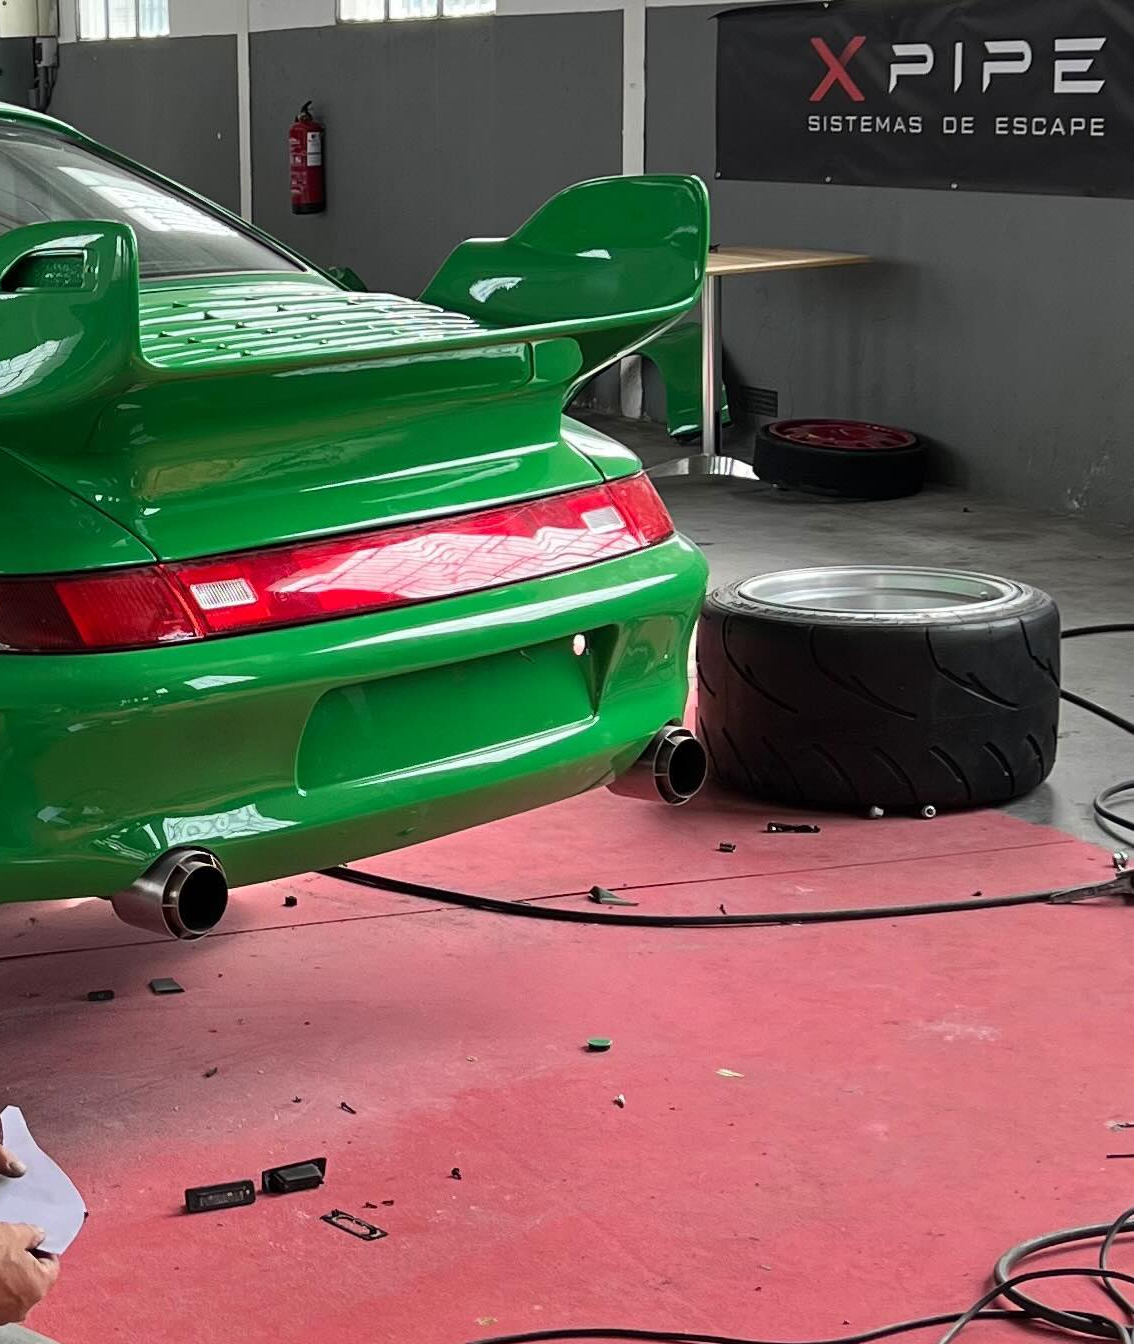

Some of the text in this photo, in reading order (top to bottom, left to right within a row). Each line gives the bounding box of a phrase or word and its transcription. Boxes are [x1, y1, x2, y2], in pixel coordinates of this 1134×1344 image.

[807, 114, 1106, 137] SISTEMAS DE ESCAPE
